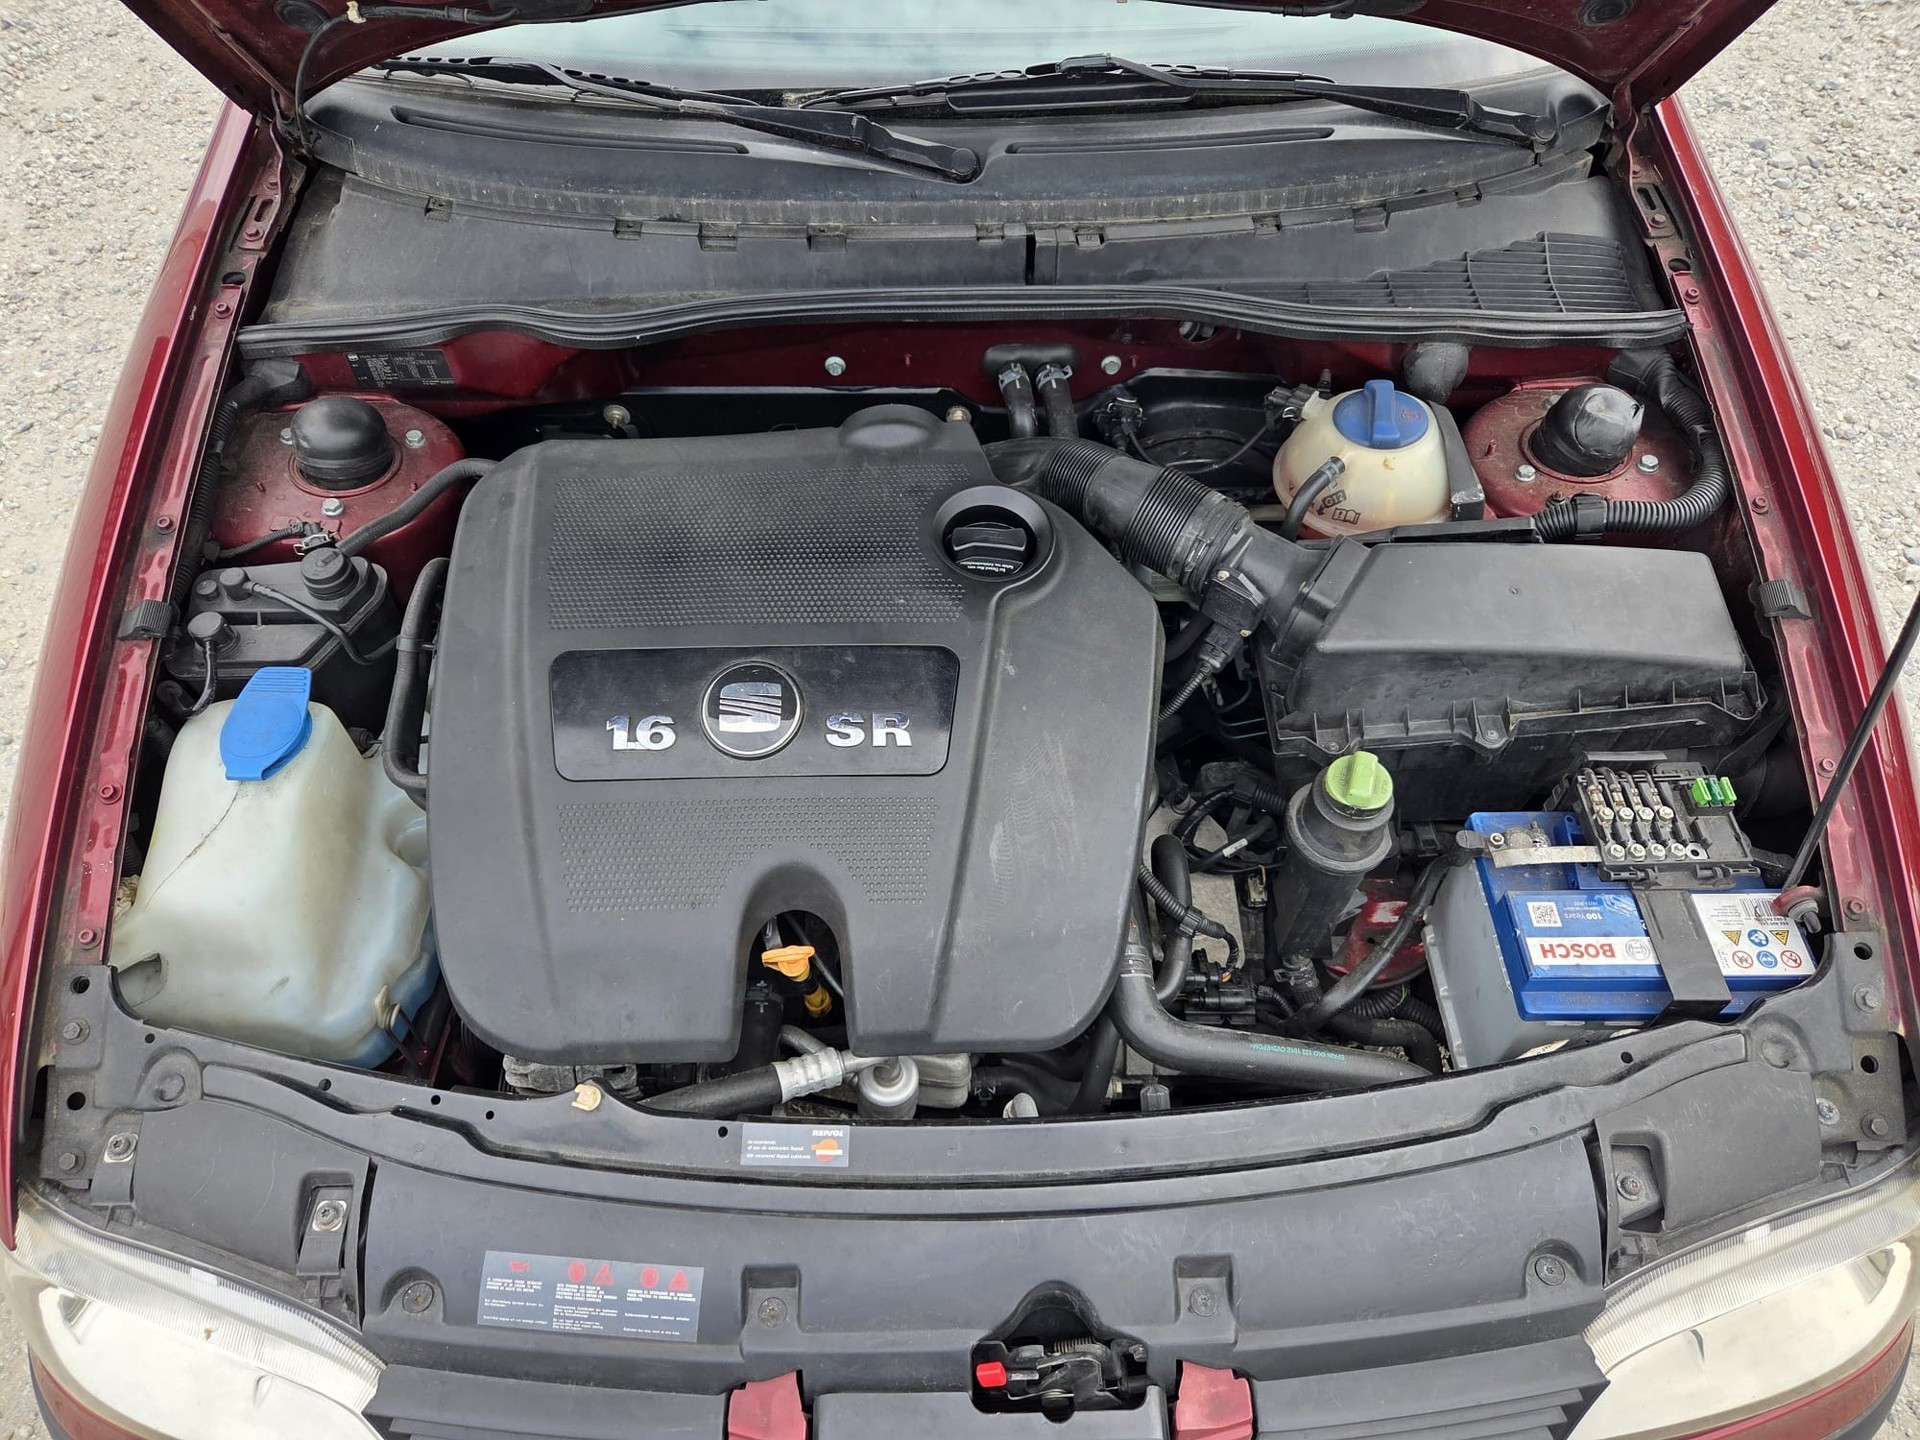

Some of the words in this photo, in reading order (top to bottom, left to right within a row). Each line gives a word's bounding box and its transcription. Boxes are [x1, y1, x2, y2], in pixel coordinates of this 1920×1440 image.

[1324, 492, 1345, 506] G12
[826, 711, 912, 747] SR
[1563, 912, 1587, 920] Years
[1586, 912, 1603, 920] 100
[1540, 943, 1616, 958] BOSCH
[812, 1129, 844, 1137] REPSOL
